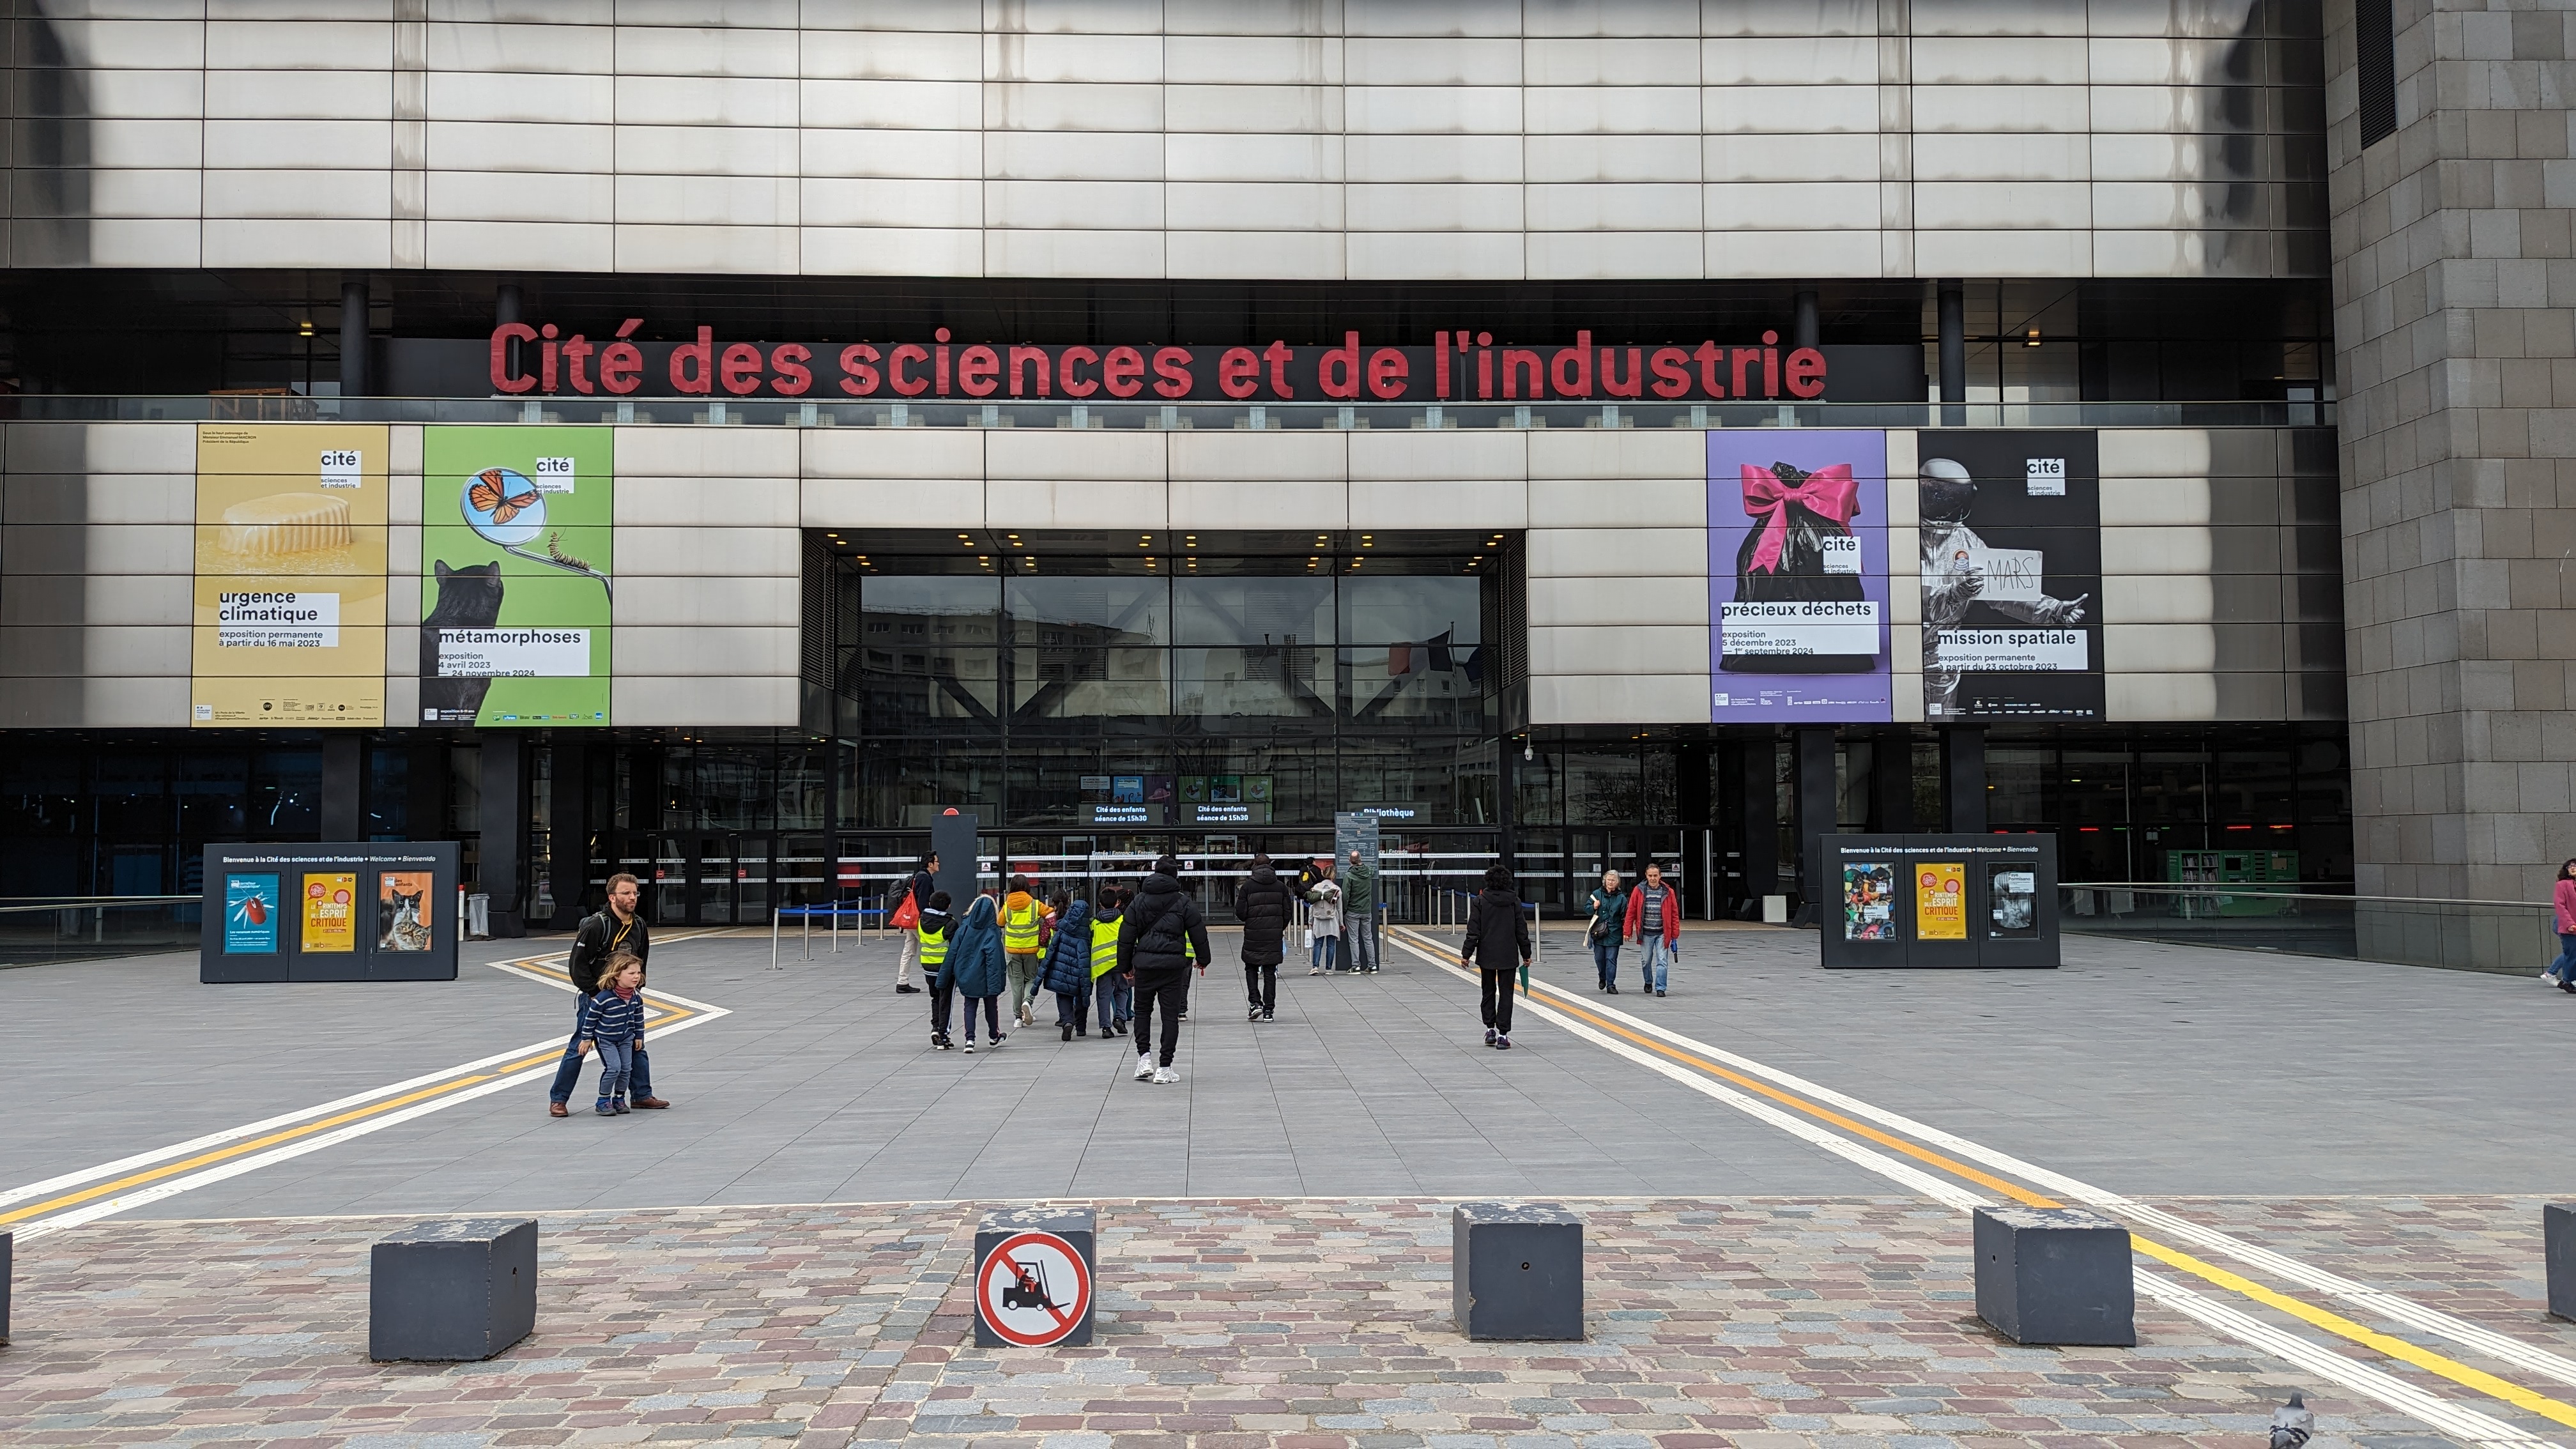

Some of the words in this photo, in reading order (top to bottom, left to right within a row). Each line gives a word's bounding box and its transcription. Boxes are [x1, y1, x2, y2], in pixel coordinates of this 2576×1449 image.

[490, 319, 644, 394] Cité
[669, 326, 812, 397] des
[839, 327, 1193, 399] sciences
[1218, 340, 1292, 399] et
[1319, 330, 1408, 399] de
[1436, 330, 1826, 400] l'industrie
[321, 450, 356, 466] cité
[537, 457, 569, 471] cité
[2027, 459, 2060, 473] cité
[1823, 536, 1856, 551] cité
[1988, 556, 2034, 593] MARS
[220, 593, 296, 607] urgence
[219, 606, 318, 624] climatique
[1721, 602, 1797, 619] précieux
[1802, 602, 1871, 616] déchets
[219, 630, 266, 639] exposition
[269, 631, 323, 640] permanente
[439, 629, 581, 647] métamorphoses
[1722, 631, 1766, 639] exposition
[1938, 630, 2003, 644] mission
[2009, 630, 2076, 647] spatiale
[226, 639, 252, 648] partir
[439, 652, 483, 661] exposition
[1938, 654, 1982, 663] exposition
[1984, 654, 2035, 663] permanente
[1925, 907, 1958, 915] CRITIQUE
[311, 918, 346, 927] CRITIQUE
